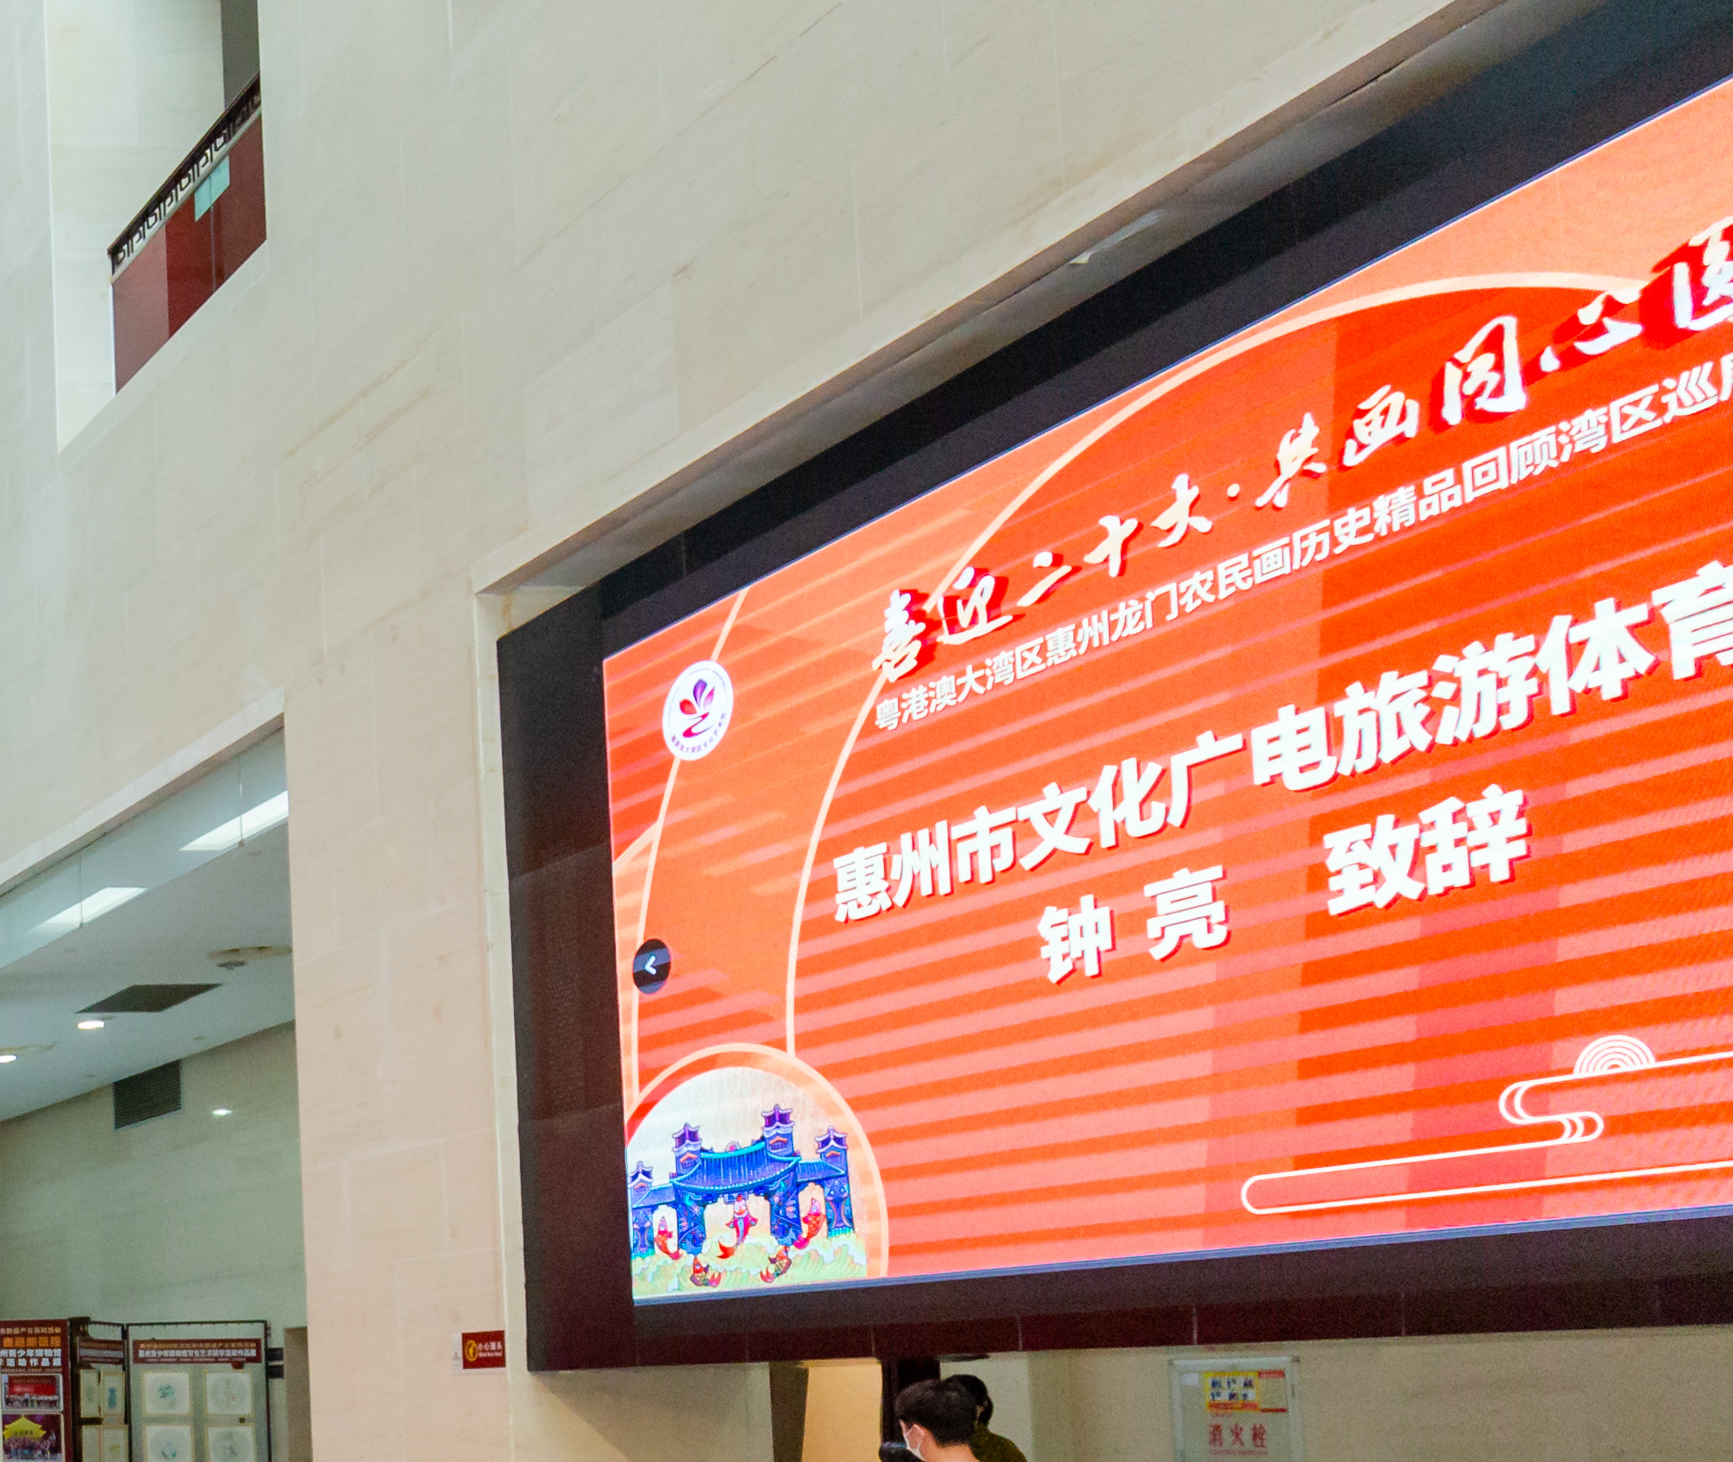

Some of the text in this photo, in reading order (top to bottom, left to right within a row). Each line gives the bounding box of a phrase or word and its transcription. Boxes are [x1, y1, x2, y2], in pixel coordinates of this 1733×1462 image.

[875, 352, 1733, 730] 粤港澳大湾区惠州龙门农民画历史精品回顾湾区巡
[833, 560, 1733, 922] 惠州市文化广电旅游体育
[1324, 783, 1529, 916] 致辞
[1209, 1424, 1267, 1448] 消火栓
